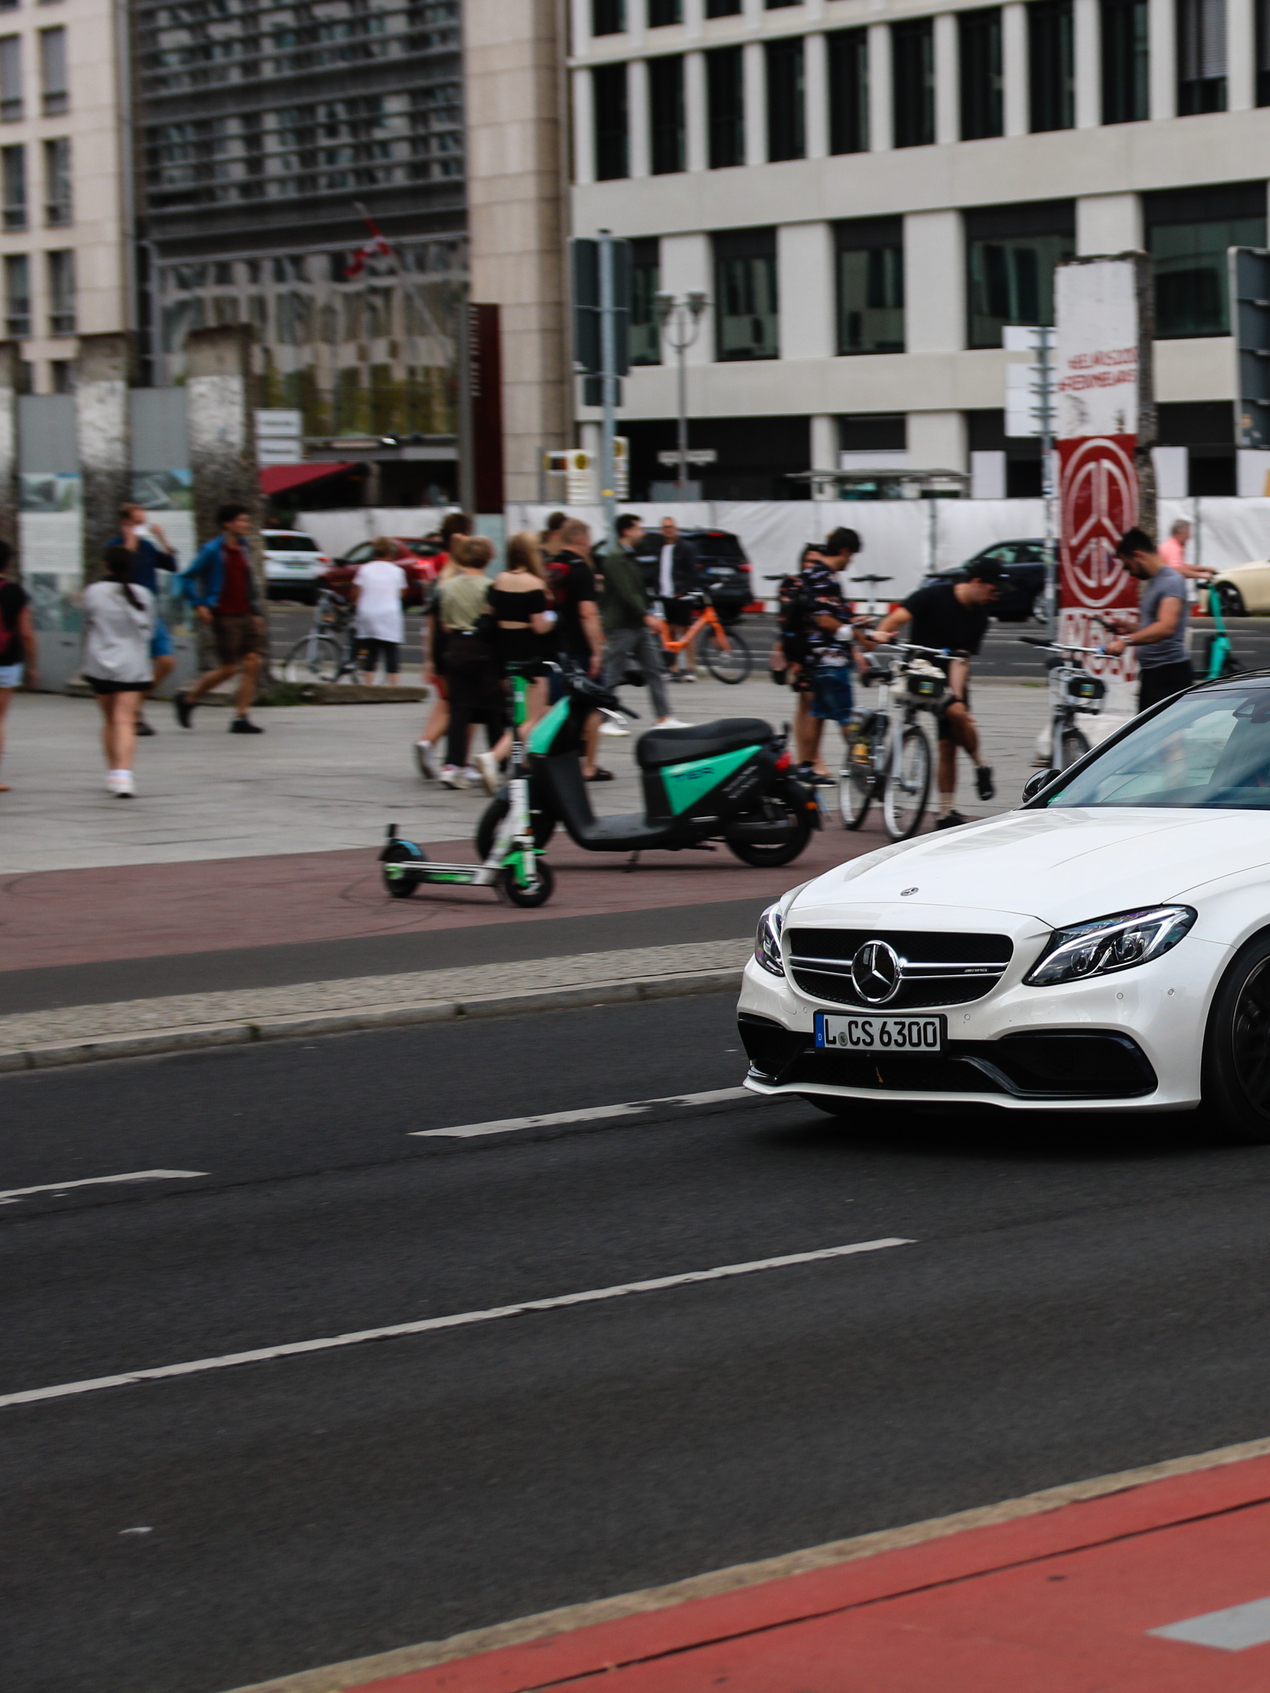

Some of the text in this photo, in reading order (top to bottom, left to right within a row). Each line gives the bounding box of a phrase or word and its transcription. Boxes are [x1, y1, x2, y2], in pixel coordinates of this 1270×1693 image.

[825, 1018, 837, 1045] L
[848, 1020, 875, 1047] CS
[880, 1021, 938, 1048] 6300
